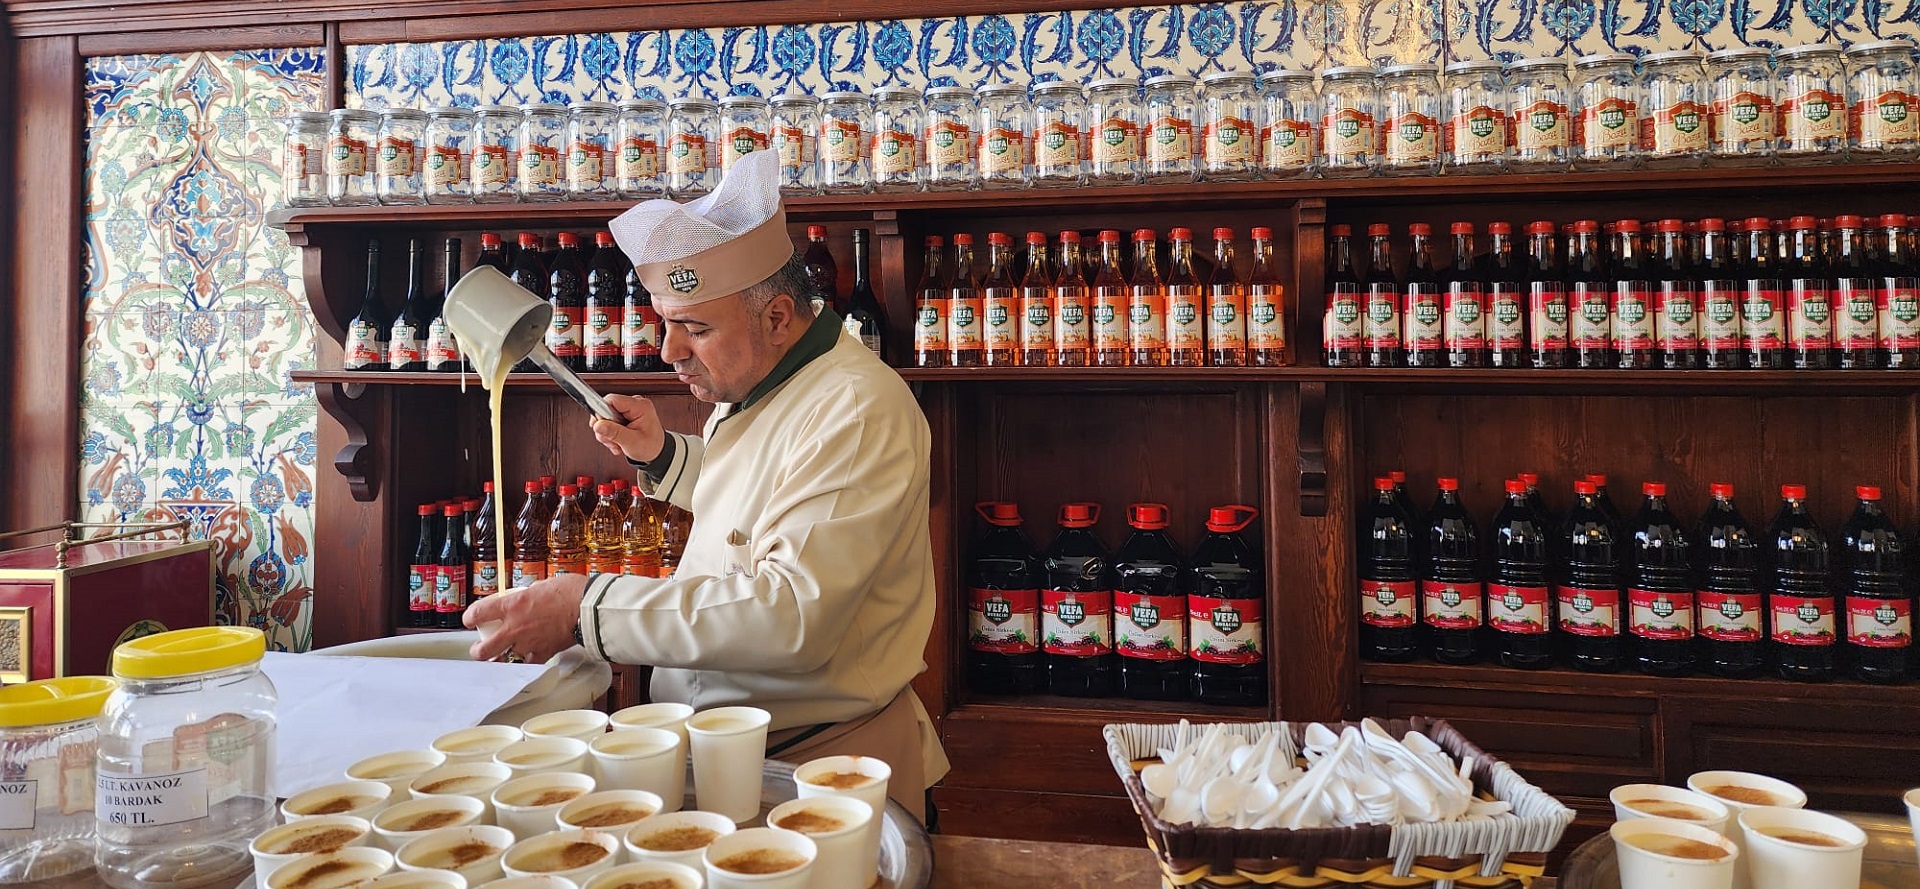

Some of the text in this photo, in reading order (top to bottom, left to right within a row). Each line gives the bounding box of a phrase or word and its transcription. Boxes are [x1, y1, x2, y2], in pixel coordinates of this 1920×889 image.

[1732, 106, 1757, 116] VEFA
[1804, 104, 1828, 114] VEFA
[1880, 105, 1906, 115] VEFA
[1533, 115, 1555, 124] VEFA
[1601, 111, 1623, 120] VEFA
[1676, 114, 1698, 124] VEFA
[1338, 121, 1358, 130] VEFA
[1401, 125, 1421, 134] VEFA
[1472, 121, 1493, 130] VEFA
[1882, 121, 1909, 136] Boza
[1104, 130, 1122, 139] VEFA
[1157, 130, 1175, 138] VEFA
[1219, 130, 1238, 139] VEFA
[1275, 132, 1294, 142] VEFA
[1530, 132, 1557, 143] Boza
[1602, 129, 1627, 142] Boza
[1673, 132, 1700, 145] Boza
[735, 140, 754, 149] VEFA
[1471, 137, 1495, 150] Boza
[670, 271, 695, 284] VEFA
[1336, 305, 1358, 314] VEFA
[1369, 305, 1391, 313] VEFA
[1416, 306, 1438, 315] VEFA
[1456, 304, 1478, 313] VEFA
[1496, 304, 1518, 313] VEFA
[1584, 305, 1607, 313] VEFA
[1618, 305, 1644, 313] VEFA
[1667, 304, 1692, 312] VEFA
[1707, 304, 1733, 312] VEFA
[1744, 304, 1770, 312] VEFA
[1805, 303, 1829, 312] VEFA
[1850, 303, 1874, 311] VEFA
[1891, 302, 1917, 310] VEFA
[1029, 309, 1049, 317] VEFA
[1063, 308, 1082, 317] VEFA
[1175, 308, 1194, 316] VEFA
[1213, 307, 1234, 316] VEFA
[1253, 307, 1274, 315] VEFA
[986, 602, 1009, 613] VEFA
[1572, 599, 1592, 607] VEFA
[1060, 604, 1083, 615] VEFA
[1721, 604, 1741, 612] VEFA
[1798, 607, 1819, 616] VEFA
[1133, 607, 1158, 619] VEFA
[1214, 612, 1239, 623] VEFA
[0, 784, 27, 794] NOZ
[120, 778, 182, 792] KAVANOZ
[114, 795, 163, 806] BARDAK
[109, 812, 154, 824] 650 TL.
